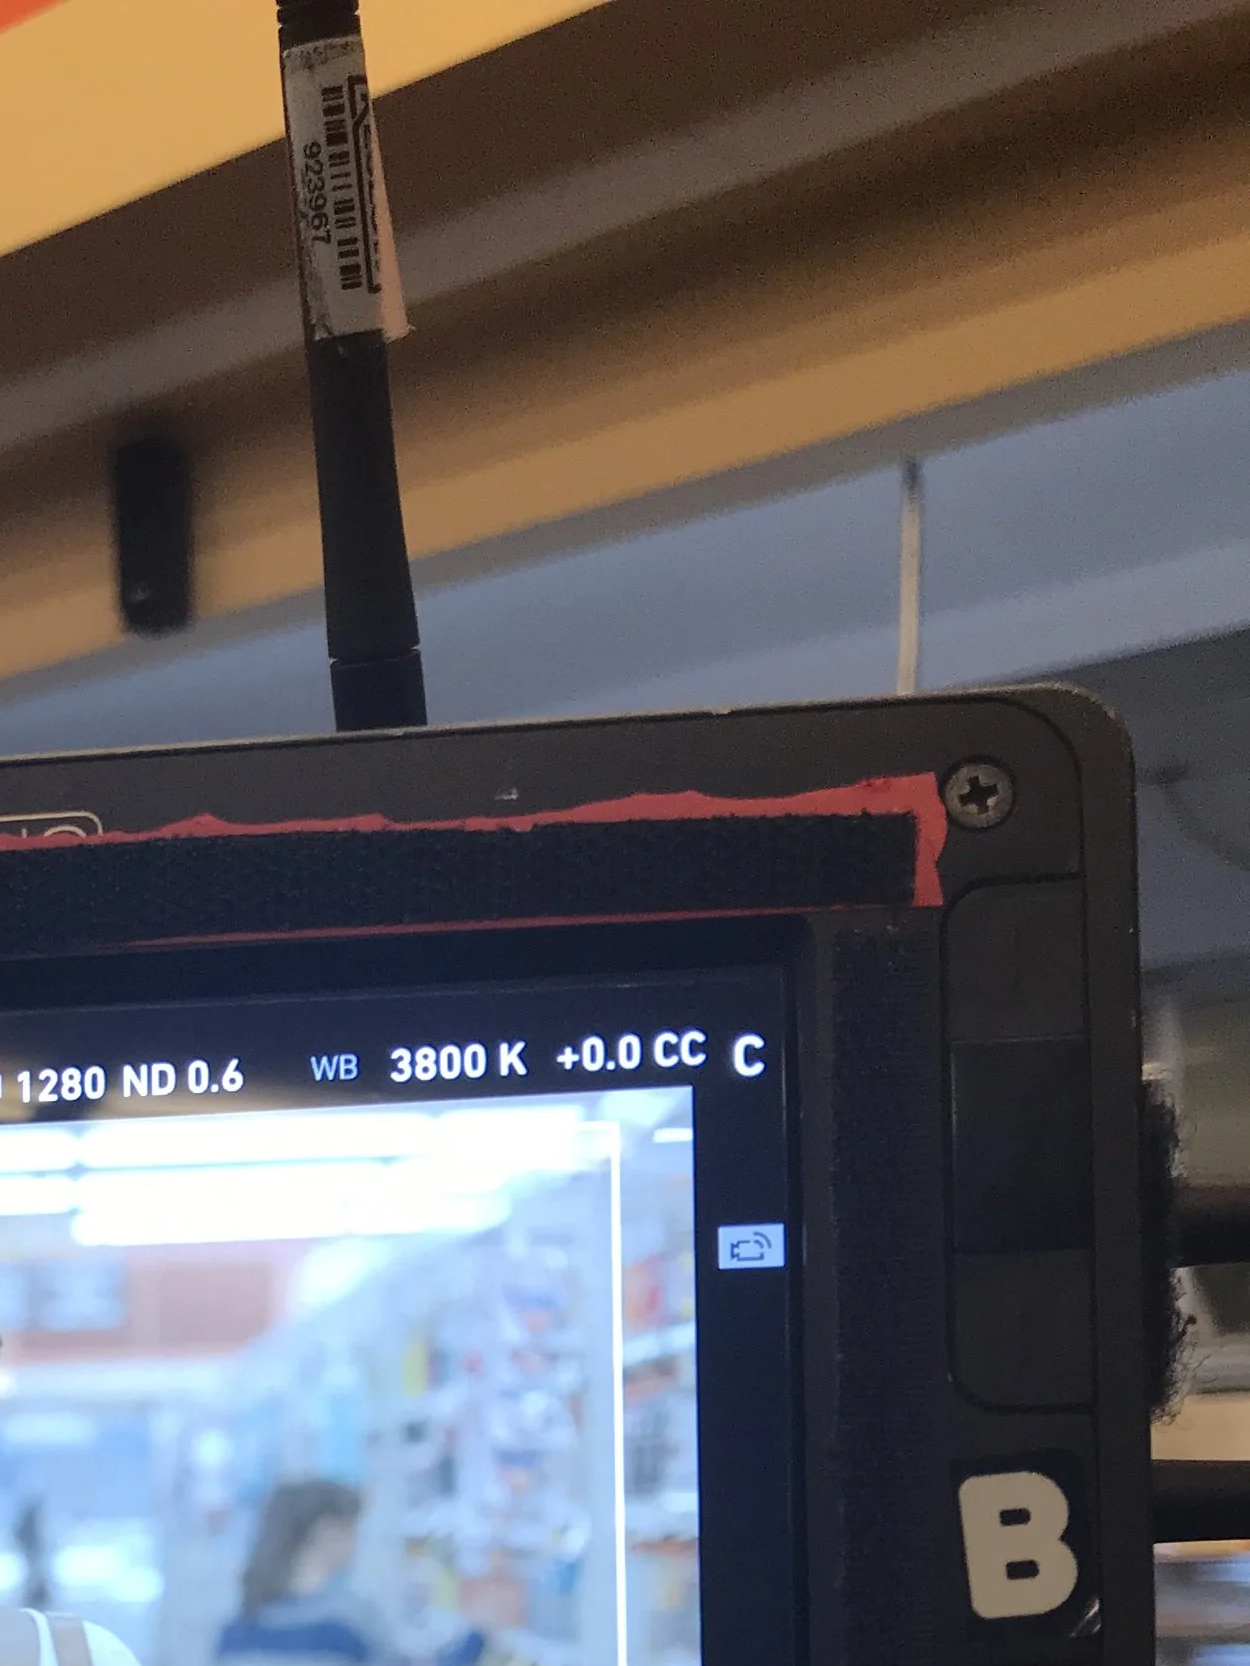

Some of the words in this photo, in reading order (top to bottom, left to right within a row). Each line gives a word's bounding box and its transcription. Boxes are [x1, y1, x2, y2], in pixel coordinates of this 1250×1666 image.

[302, 142, 331, 245] 923967
[309, 1052, 360, 1082] WB
[388, 1040, 488, 1084] 3800
[498, 1040, 529, 1078] K
[555, 1031, 643, 1074] +0.0
[650, 1026, 707, 1069] CC
[730, 1031, 767, 1078] C
[16, 1065, 106, 1104] 1280
[122, 1062, 177, 1097] ND
[186, 1057, 245, 1095] 0.6
[958, 1471, 1078, 1619] B
